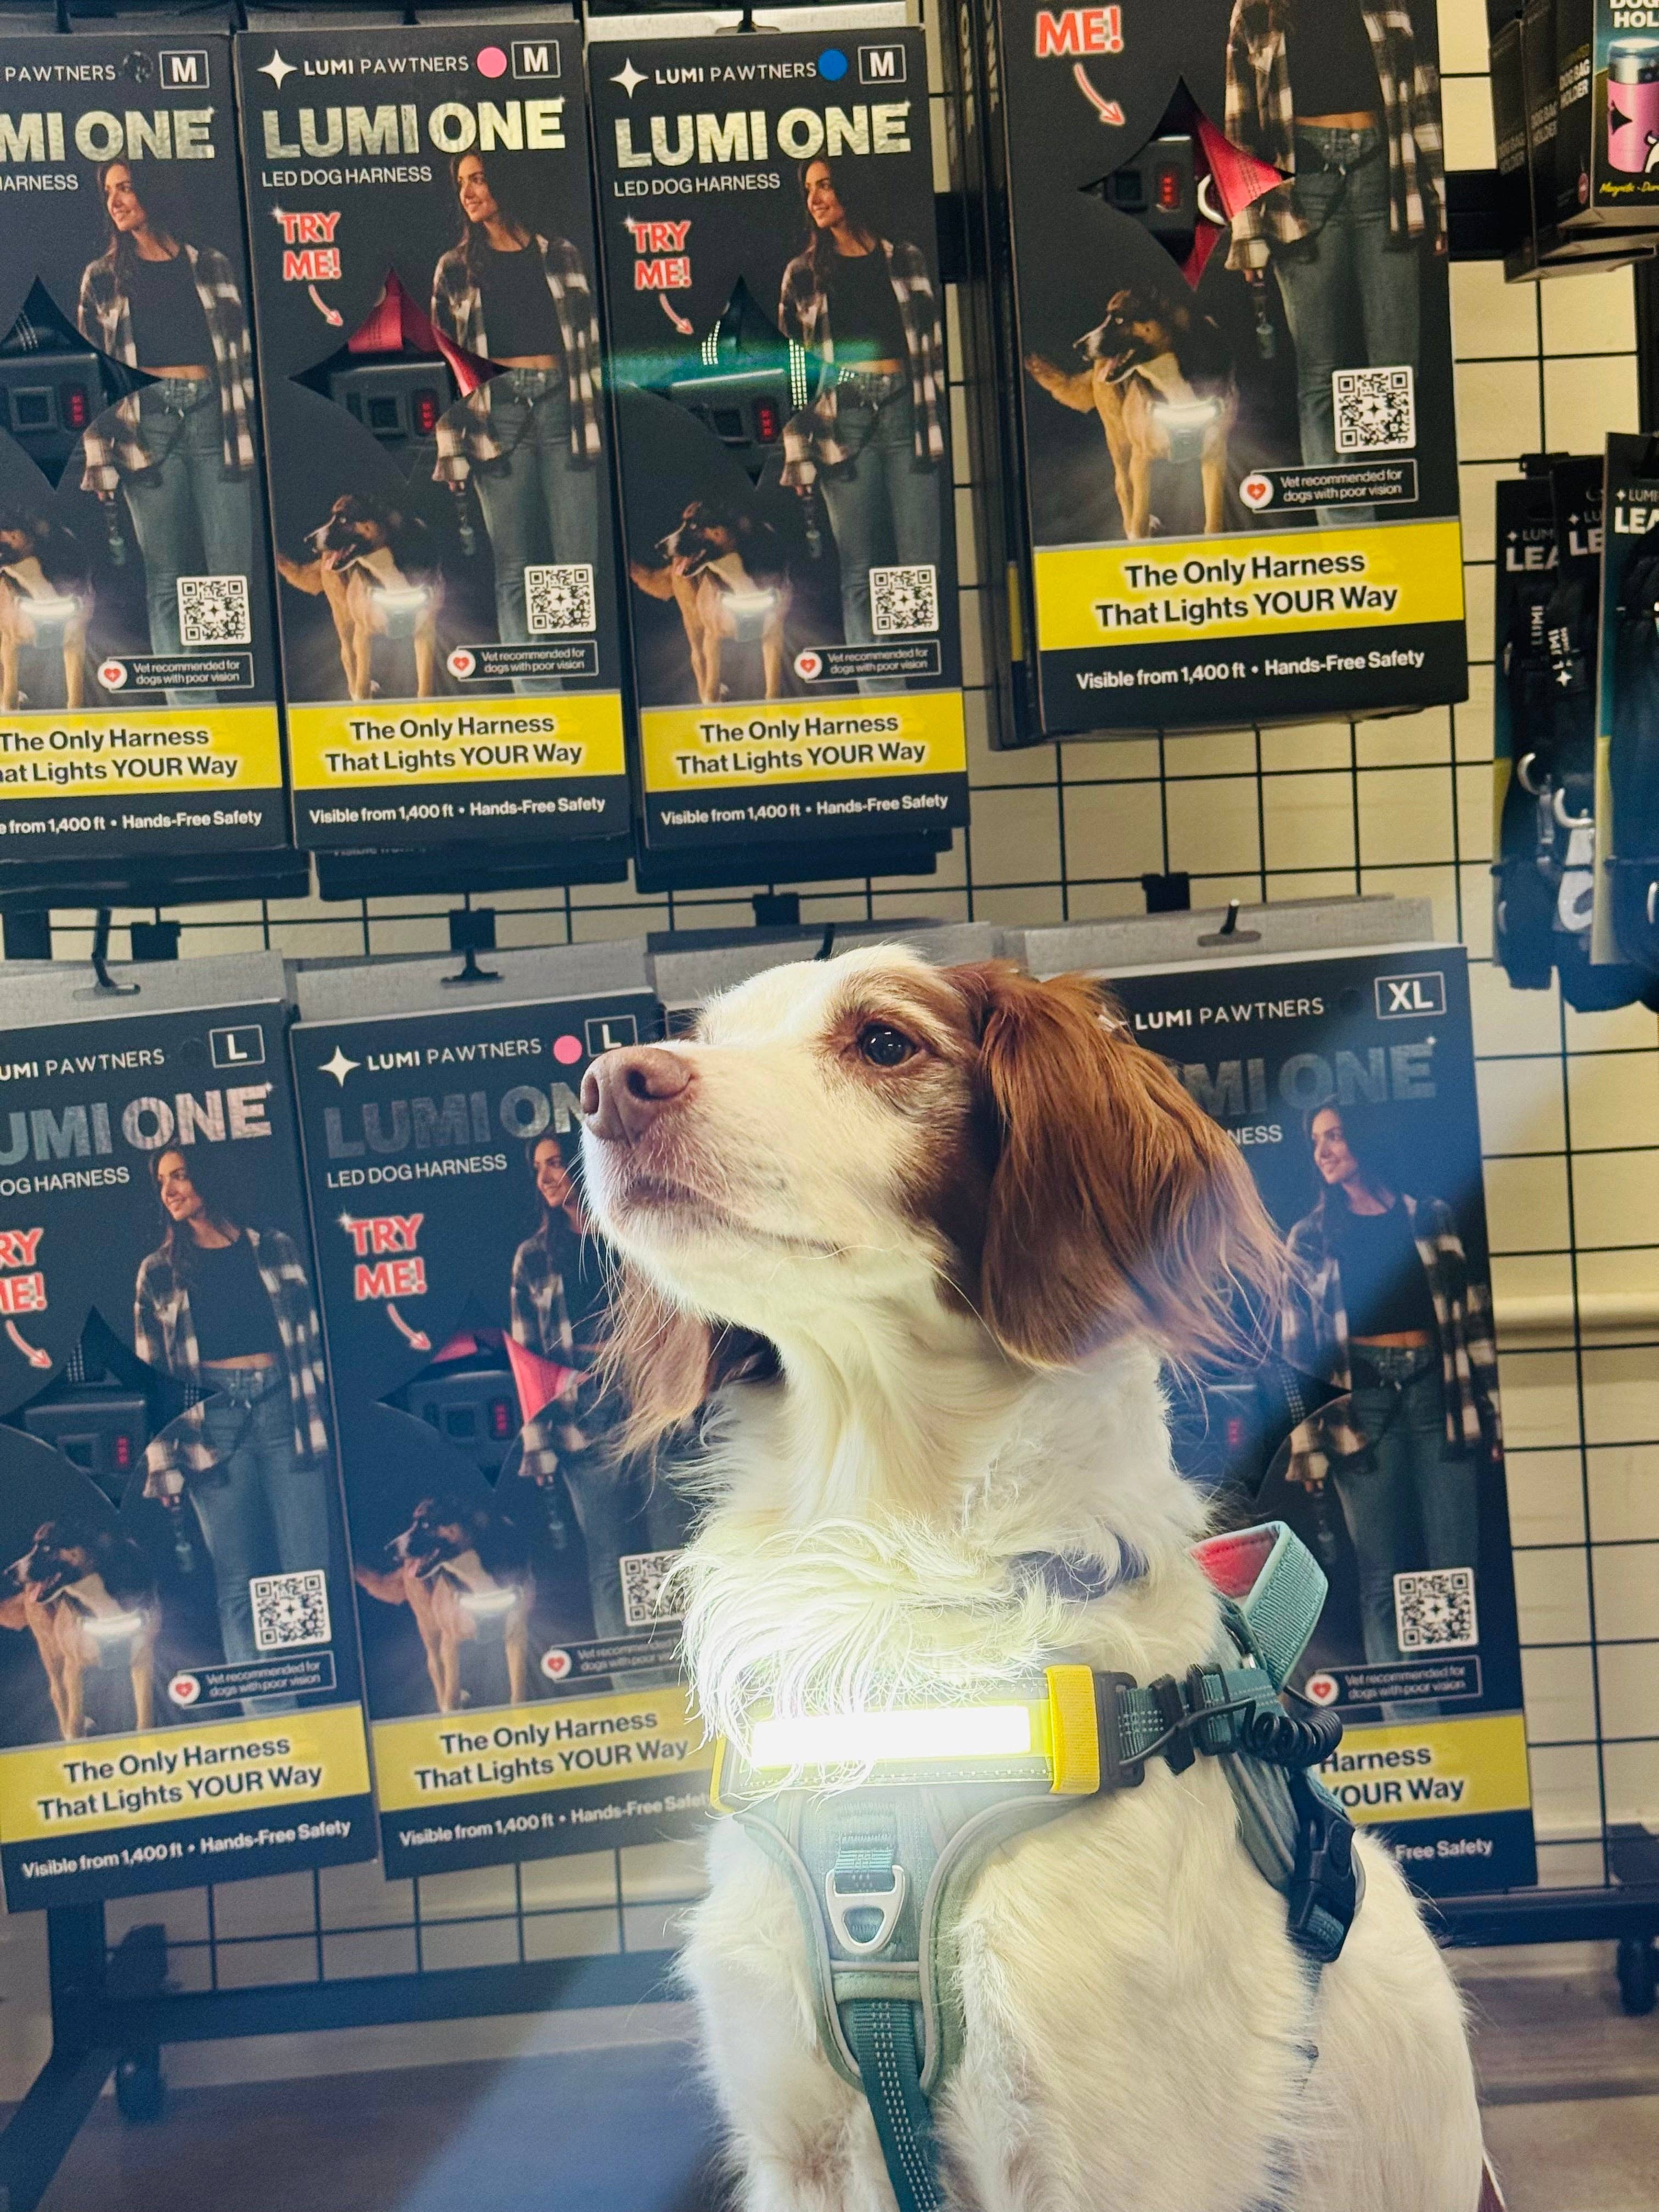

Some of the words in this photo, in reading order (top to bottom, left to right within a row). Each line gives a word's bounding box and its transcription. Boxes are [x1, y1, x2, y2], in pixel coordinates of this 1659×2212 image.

[1036, 6, 1123, 57] ME!
[5, 65, 115, 81] PAWTNERS
[172, 57, 196, 82] M
[304, 59, 353, 75] LUMI
[360, 56, 469, 74] PAWTNERS
[524, 47, 548, 72] M
[656, 68, 703, 84] LUMI
[710, 63, 816, 81] PAWTNERS
[870, 52, 894, 76] M
[0, 112, 65, 162] MI
[75, 109, 215, 162] ONE
[263, 104, 419, 159] LUMI
[429, 97, 565, 153] ONE
[616, 111, 768, 167] LUMI
[777, 101, 911, 159] ONE
[0, 174, 78, 190] ARNESS
[262, 171, 297, 187] LED
[301, 169, 342, 185] DOG
[346, 166, 432, 183] HARNESS
[614, 180, 648, 196] LED
[652, 178, 692, 194] DOG
[696, 173, 780, 192] HARNESS
[278, 212, 341, 244] TRY
[630, 220, 692, 254] TRY
[284, 249, 341, 280] ME!
[635, 257, 692, 290] ME!
[1280, 477, 1299, 488] Vet
[1301, 470, 1385, 486] recommended
[1387, 470, 1402, 480] for
[1284, 491, 1312, 503] dogs
[1314, 488, 1339, 499] with
[1340, 489, 1367, 500] poor
[1369, 485, 1402, 495] vision
[1615, 507, 1659, 534] LEA
[1125, 565, 1177, 588] The
[1184, 559, 1245, 587] Only
[1252, 554, 1364, 579] Harness
[1096, 603, 1158, 627] That
[1165, 597, 1248, 627] Lights
[1254, 589, 1334, 617] YOUR
[1340, 586, 1397, 613] Way
[482, 652, 498, 661] Vet
[499, 648, 571, 661] recommended
[572, 648, 585, 657] for
[484, 664, 509, 674] dogs
[510, 662, 531, 671] with
[532, 663, 555, 672] poor
[1077, 671, 1134, 689] Visible
[1137, 669, 1178, 685] from
[1181, 664, 1229, 684] 1,400
[1232, 662, 1245, 680] ft
[1265, 655, 1365, 675] Hands-Free
[1368, 650, 1424, 670] Safety
[0, 733, 44, 752] The
[49, 730, 104, 752] Only
[110, 729, 208, 747] Harness
[350, 722, 394, 740] The
[400, 719, 453, 740] Only
[459, 717, 554, 735] Harness
[700, 724, 743, 742] The
[749, 720, 799, 741] Only
[805, 718, 898, 736] Harness
[0, 765, 27, 782] at
[33, 761, 107, 785] Lights
[112, 758, 182, 777] YOUR
[188, 757, 237, 777] Way
[325, 753, 379, 771] That
[384, 750, 455, 772] Lights
[460, 745, 528, 765] YOUR
[533, 744, 582, 765] Way
[676, 755, 728, 774] That
[733, 751, 803, 774] Lights
[807, 744, 873, 765] YOUR
[878, 742, 925, 765] Way
[9, 820, 46, 833] from
[48, 817, 91, 833] 1,400
[94, 817, 105, 830] ft
[122, 812, 211, 828] Hands-Free
[213, 810, 262, 826] Safety
[309, 809, 358, 823] Visible
[361, 808, 396, 822] from
[399, 805, 439, 821] 1,400
[442, 804, 453, 817] ft
[470, 800, 555, 815] Hands-Free
[558, 798, 605, 812] Safety
[661, 810, 708, 825] Visible
[711, 809, 745, 822] from
[748, 805, 787, 821] 1,400
[790, 804, 800, 817] ft
[817, 798, 900, 815] Hands-Free
[902, 794, 948, 811] Safety
[1136, 1009, 1192, 1030] LUMI
[1200, 997, 1324, 1024] PAWTNERS
[1389, 981, 1433, 1011] XL
[0, 1062, 38, 1080] UMI
[46, 1048, 164, 1076] PAWTNERS
[227, 1034, 247, 1059] L
[368, 1051, 420, 1070] LUMI
[427, 1039, 541, 1064] PAWTNERS
[602, 1024, 621, 1048] L
[1182, 1058, 1268, 1116] MI
[1278, 1044, 1436, 1111] ONE
[123, 1082, 273, 1149] ONE
[324, 1091, 491, 1159] LUMI
[1228, 1125, 1283, 1145] NESS
[0, 1178, 31, 1195] OG
[35, 1167, 129, 1192] HARNESS
[328, 1170, 364, 1188] LED
[368, 1164, 412, 1183] DOG
[416, 1154, 507, 1178] HARNESS
[347, 1213, 425, 1255] TRY
[355, 1257, 427, 1300] ME!
[440, 1734, 488, 1754] The
[494, 1724, 549, 1749] Only
[555, 1714, 657, 1740] Harness
[64, 1762, 114, 1783] The
[120, 1751, 177, 1775] Only
[184, 1740, 290, 1767] Harness
[415, 1766, 472, 1790] That
[477, 1757, 554, 1784] Lights
[558, 1745, 631, 1771] YOUR
[636, 1740, 687, 1762] Way
[1320, 1747, 1432, 1774] Harness
[38, 1798, 97, 1821] That
[103, 1785, 182, 1813] Lights
[188, 1771, 263, 1798] YOUR
[268, 1766, 321, 1791] Way
[1333, 1781, 1402, 1807] OUR
[1407, 1778, 1464, 1802] Way
[400, 1827, 452, 1846] Visible
[455, 1824, 493, 1839] from
[495, 1815, 539, 1836] 1,400
[541, 1814, 553, 1827] ft
[571, 1801, 663, 1824] Hands-Free
[22, 1859, 77, 1877] Visible
[80, 1854, 119, 1870] from
[122, 1844, 167, 1866] 1,400
[170, 1843, 182, 1857] ft
[201, 1829, 296, 1853] Hands-Free
[298, 1820, 351, 1841] Safety
[1437, 1839, 1492, 1857] Safety
